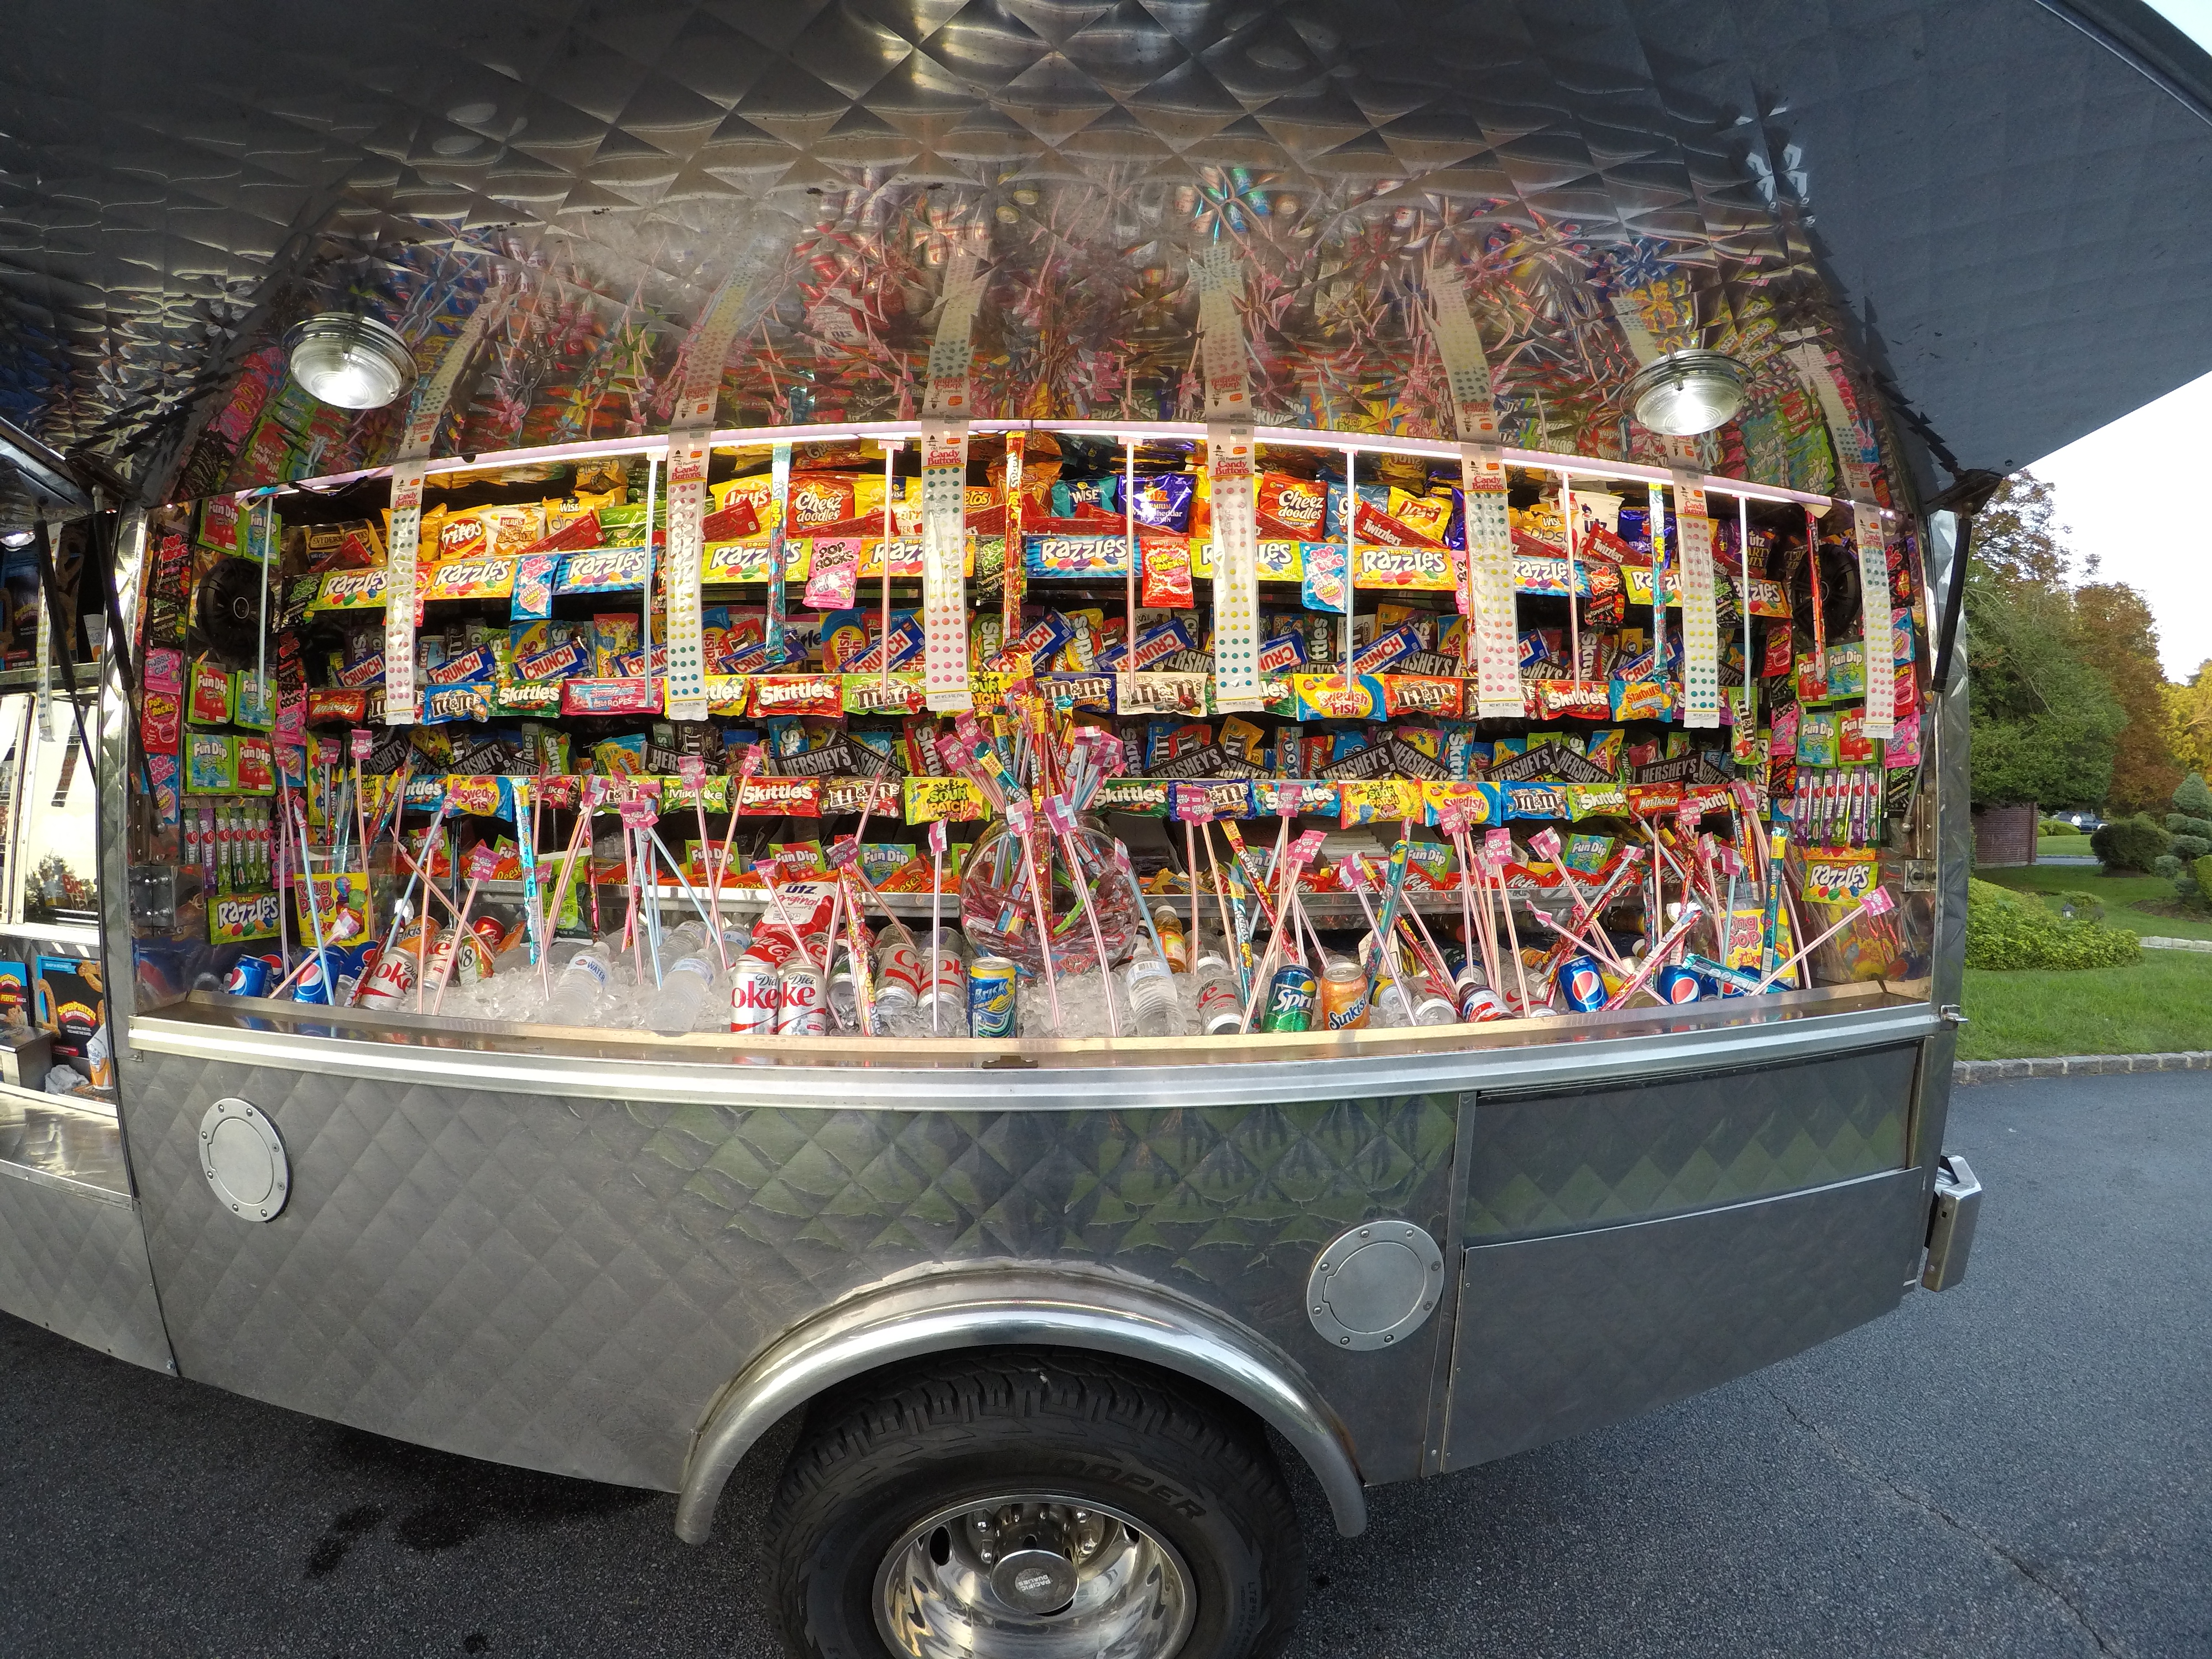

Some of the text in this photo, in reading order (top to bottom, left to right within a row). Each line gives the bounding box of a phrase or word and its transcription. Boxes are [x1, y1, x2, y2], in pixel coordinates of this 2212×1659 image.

[930, 450, 959, 460] Candy
[675, 465, 700, 473] Candy
[1006, 452, 1020, 488] Nerds
[1218, 461, 1247, 469] Candy
[671, 472, 701, 480] Buttons
[1474, 476, 1501, 484] Candy
[395, 499, 418, 508] Buttons
[795, 491, 842, 513] Cheez
[1073, 489, 1098, 504] WISE
[1279, 491, 1324, 509] Cheez
[208, 501, 238, 524] Fun Dip
[560, 503, 580, 512] WISE
[796, 509, 840, 523] doodles
[1279, 506, 1322, 520] doodles
[1364, 519, 1401, 546] Twizzlers
[818, 542, 846, 557] POP
[1042, 540, 1126, 562] Razzles
[1593, 540, 1624, 562] Twizzlers
[1654, 536, 1663, 562] Rope
[568, 549, 645, 579] Razzles
[815, 554, 854, 571] ROCKS
[1150, 555, 1168, 566] POP
[1363, 552, 1446, 574] Razzles
[1748, 557, 1765, 567] MIX
[323, 566, 389, 597] Razzles
[436, 560, 510, 586] Razzles
[1770, 633, 1788, 648] ROCKS
[435, 653, 480, 684] CRUNCH
[524, 649, 574, 681] CRUNCH
[1829, 651, 1863, 668] Fun Dip
[154, 663, 169, 675] GUM
[343, 659, 382, 686] CRUNCH
[197, 675, 214, 688] Fun
[215, 678, 227, 694] Dip
[148, 697, 163, 708] POP
[280, 693, 302, 709] ROCKS
[498, 684, 559, 705] Skittles
[608, 698, 633, 707] ROPES
[760, 684, 834, 705] Skittles
[152, 703, 175, 717] ROCKS
[1802, 723, 1834, 738] Fun Dip
[1841, 719, 1856, 733] Fun
[194, 744, 228, 762] Fun Dip
[239, 747, 255, 760] Fun
[255, 748, 272, 765] Dip
[784, 747, 852, 775] HERSHEY'S
[1030, 750, 1039, 785] Nerds
[1156, 749, 1218, 778] HERSHEY'S
[1322, 747, 1387, 779] HERSHEY'S
[1494, 749, 1550, 781] HERSHEY'S
[1642, 758, 1697, 780] HERSHEY'S
[743, 786, 812, 804] Skittles
[930, 787, 967, 802] SOUR
[1095, 788, 1165, 808] Skittles
[1369, 787, 1394, 799] SOUR
[1369, 796, 1399, 806] PATCH
[928, 801, 969, 815] PATCH
[863, 850, 909, 865] Fun Dip
[1572, 842, 1607, 857] Fun Dip
[776, 852, 818, 866] Fun Dip
[1238, 849, 1259, 878] Nerds
[1427, 852, 1446, 867] Dip
[1810, 864, 1869, 888] Razzles
[62, 874, 85, 899] Big
[786, 885, 815, 894] utz
[218, 896, 278, 928] Razzles
[1234, 910, 1250, 940] Nerds
[460, 947, 473, 968] V8
[1240, 942, 1252, 967] Rope
[1742, 955, 1752, 964] 40
[587, 961, 606, 982] WATER
[789, 974, 815, 987] Diet
[974, 982, 1008, 1003] Brisk
[58, 1001, 96, 1020] SUPERPRETZEL
[1018, 1574, 1048, 1586] DUALIES
[1020, 1578, 1051, 1591] PACIFIC
